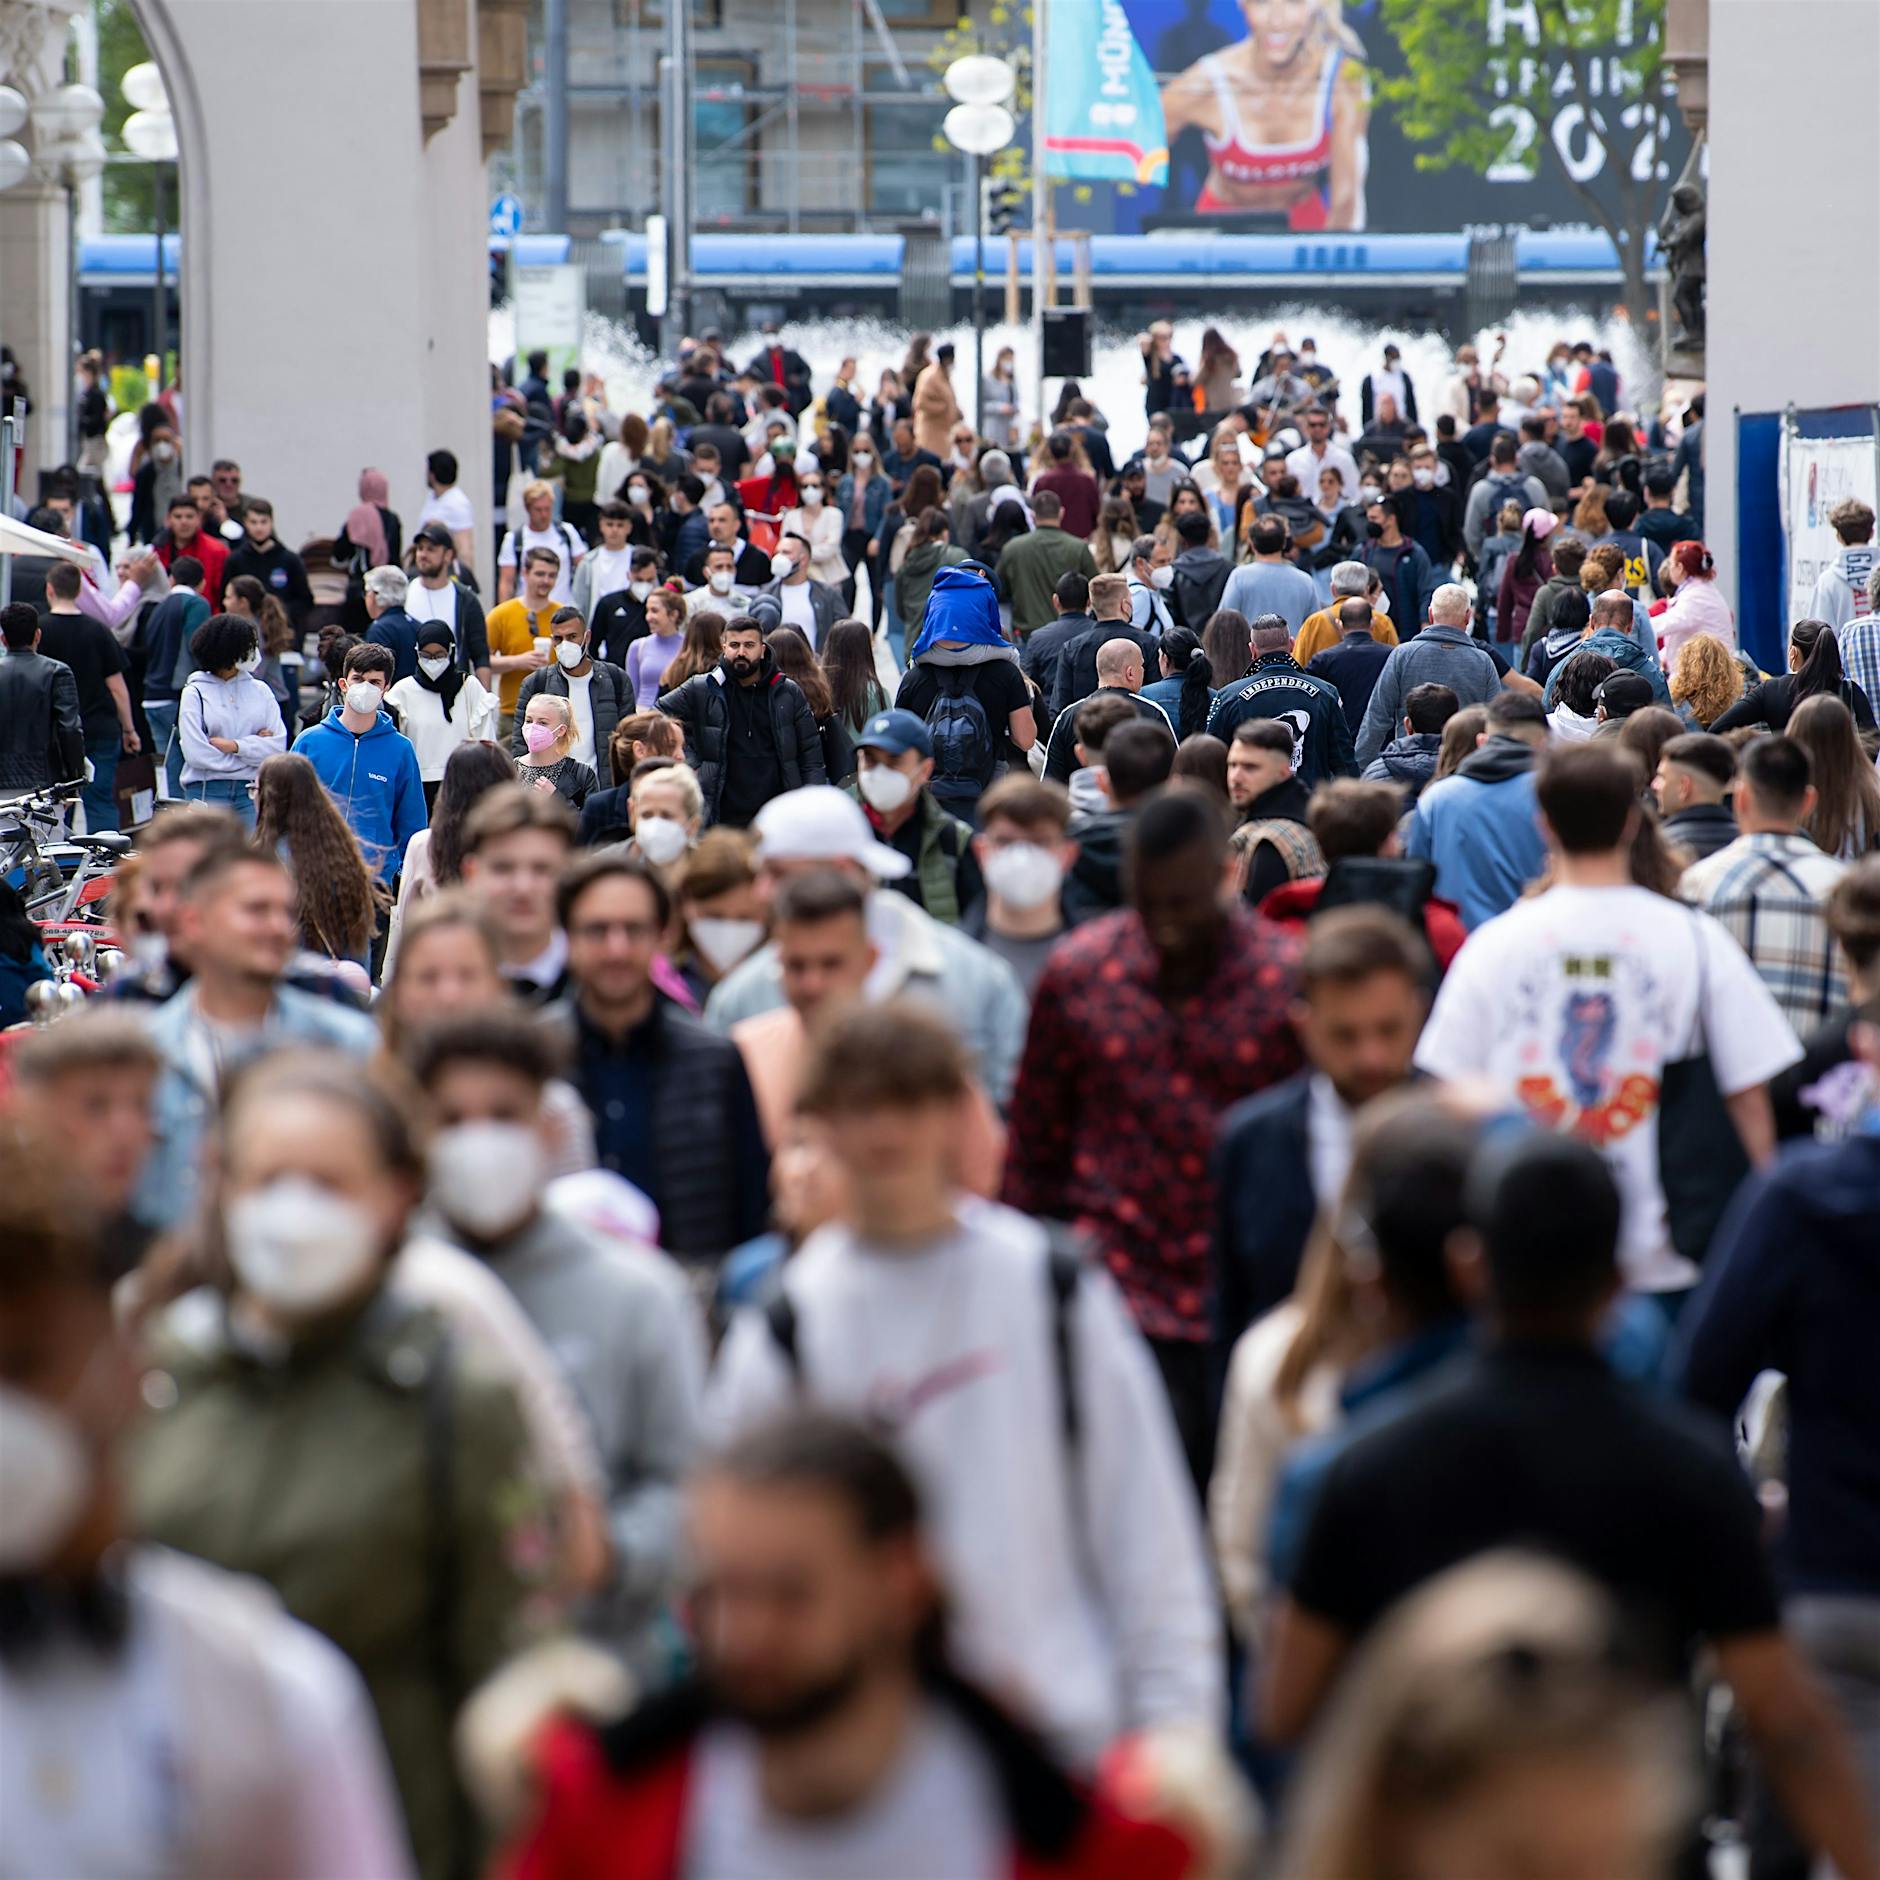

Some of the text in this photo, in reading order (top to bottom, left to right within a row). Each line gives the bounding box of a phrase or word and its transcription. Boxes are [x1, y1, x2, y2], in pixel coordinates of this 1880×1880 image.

[1096, 0, 1132, 96] MÜN
[1484, 102, 1708, 182] 202
[1241, 677, 1317, 698] INDEPENDENT
